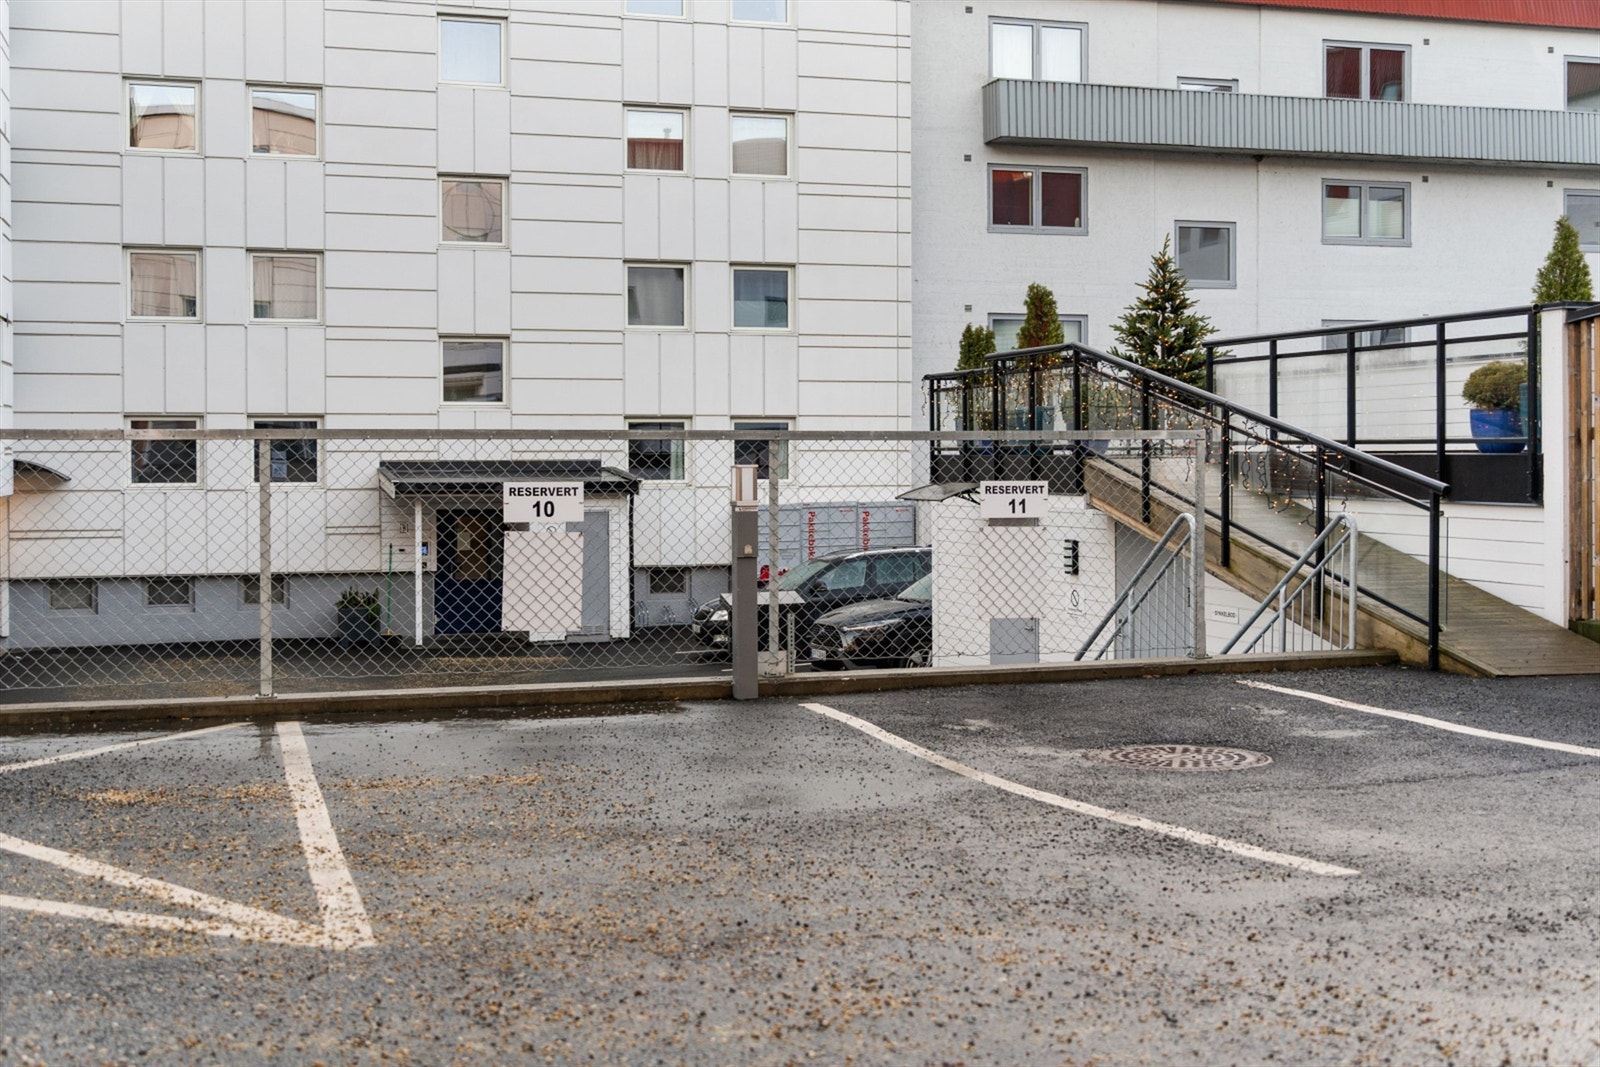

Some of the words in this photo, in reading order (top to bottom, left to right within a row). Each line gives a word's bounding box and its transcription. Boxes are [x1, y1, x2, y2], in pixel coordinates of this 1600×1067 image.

[509, 487, 579, 497] RESERVERT
[985, 485, 1045, 495] RESERVERT
[532, 500, 555, 518] 10
[1008, 498, 1026, 514] 11
